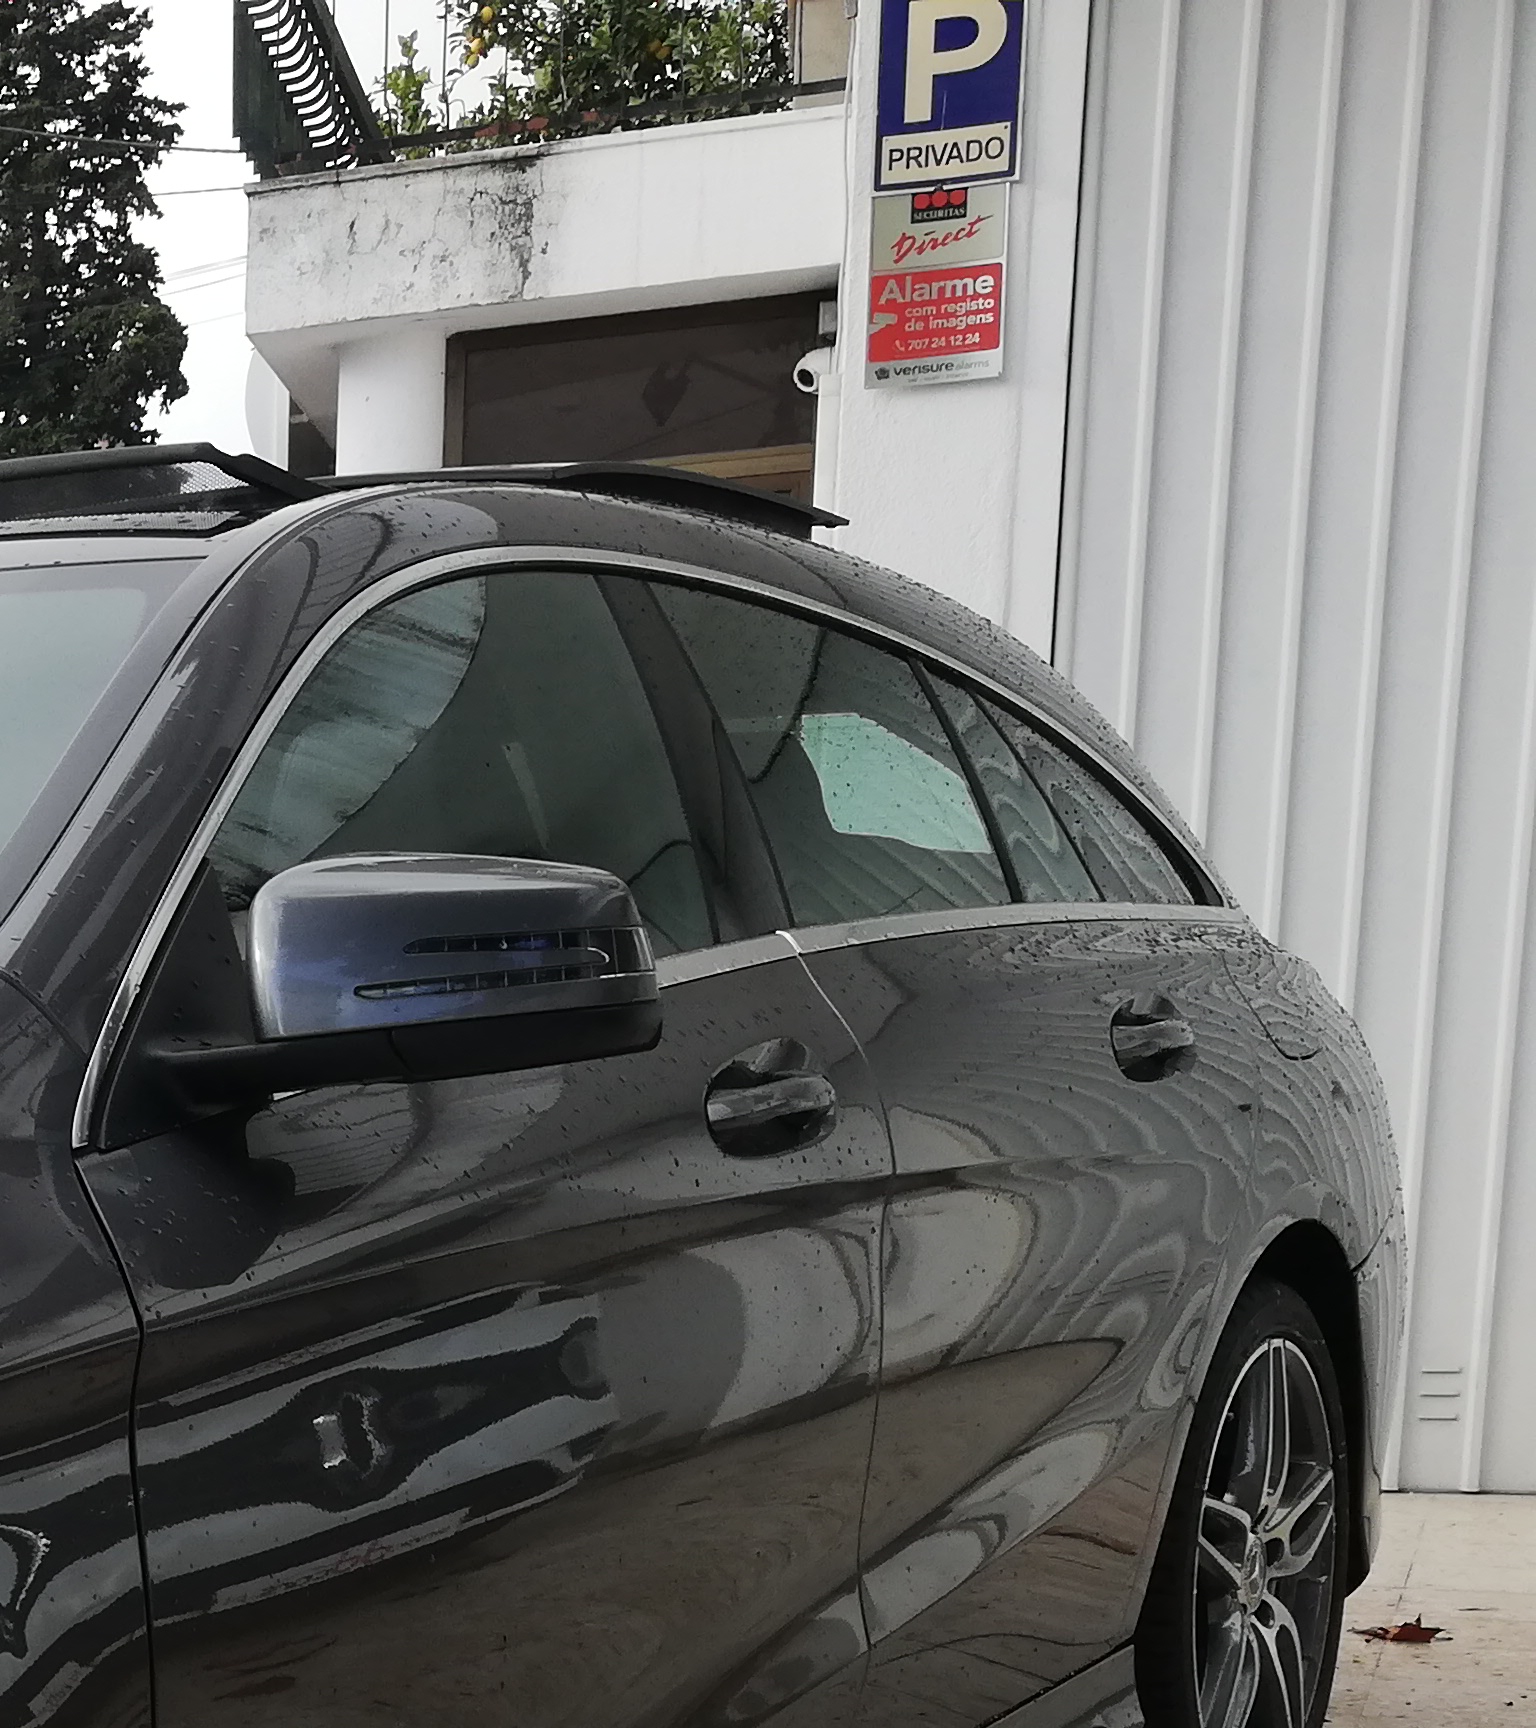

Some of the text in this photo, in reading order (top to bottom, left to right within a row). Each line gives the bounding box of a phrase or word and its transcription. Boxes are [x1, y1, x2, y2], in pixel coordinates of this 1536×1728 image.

[904, 0, 1008, 124] P
[888, 136, 1005, 171] PRIVADO
[913, 207, 966, 220] SECURITAS
[890, 214, 994, 264] Direct
[878, 275, 995, 305] Alarme
[904, 297, 995, 318] com registo
[904, 312, 994, 332] de imagens
[907, 332, 980, 350] 707 24 12 24
[893, 361, 955, 377] verisure
